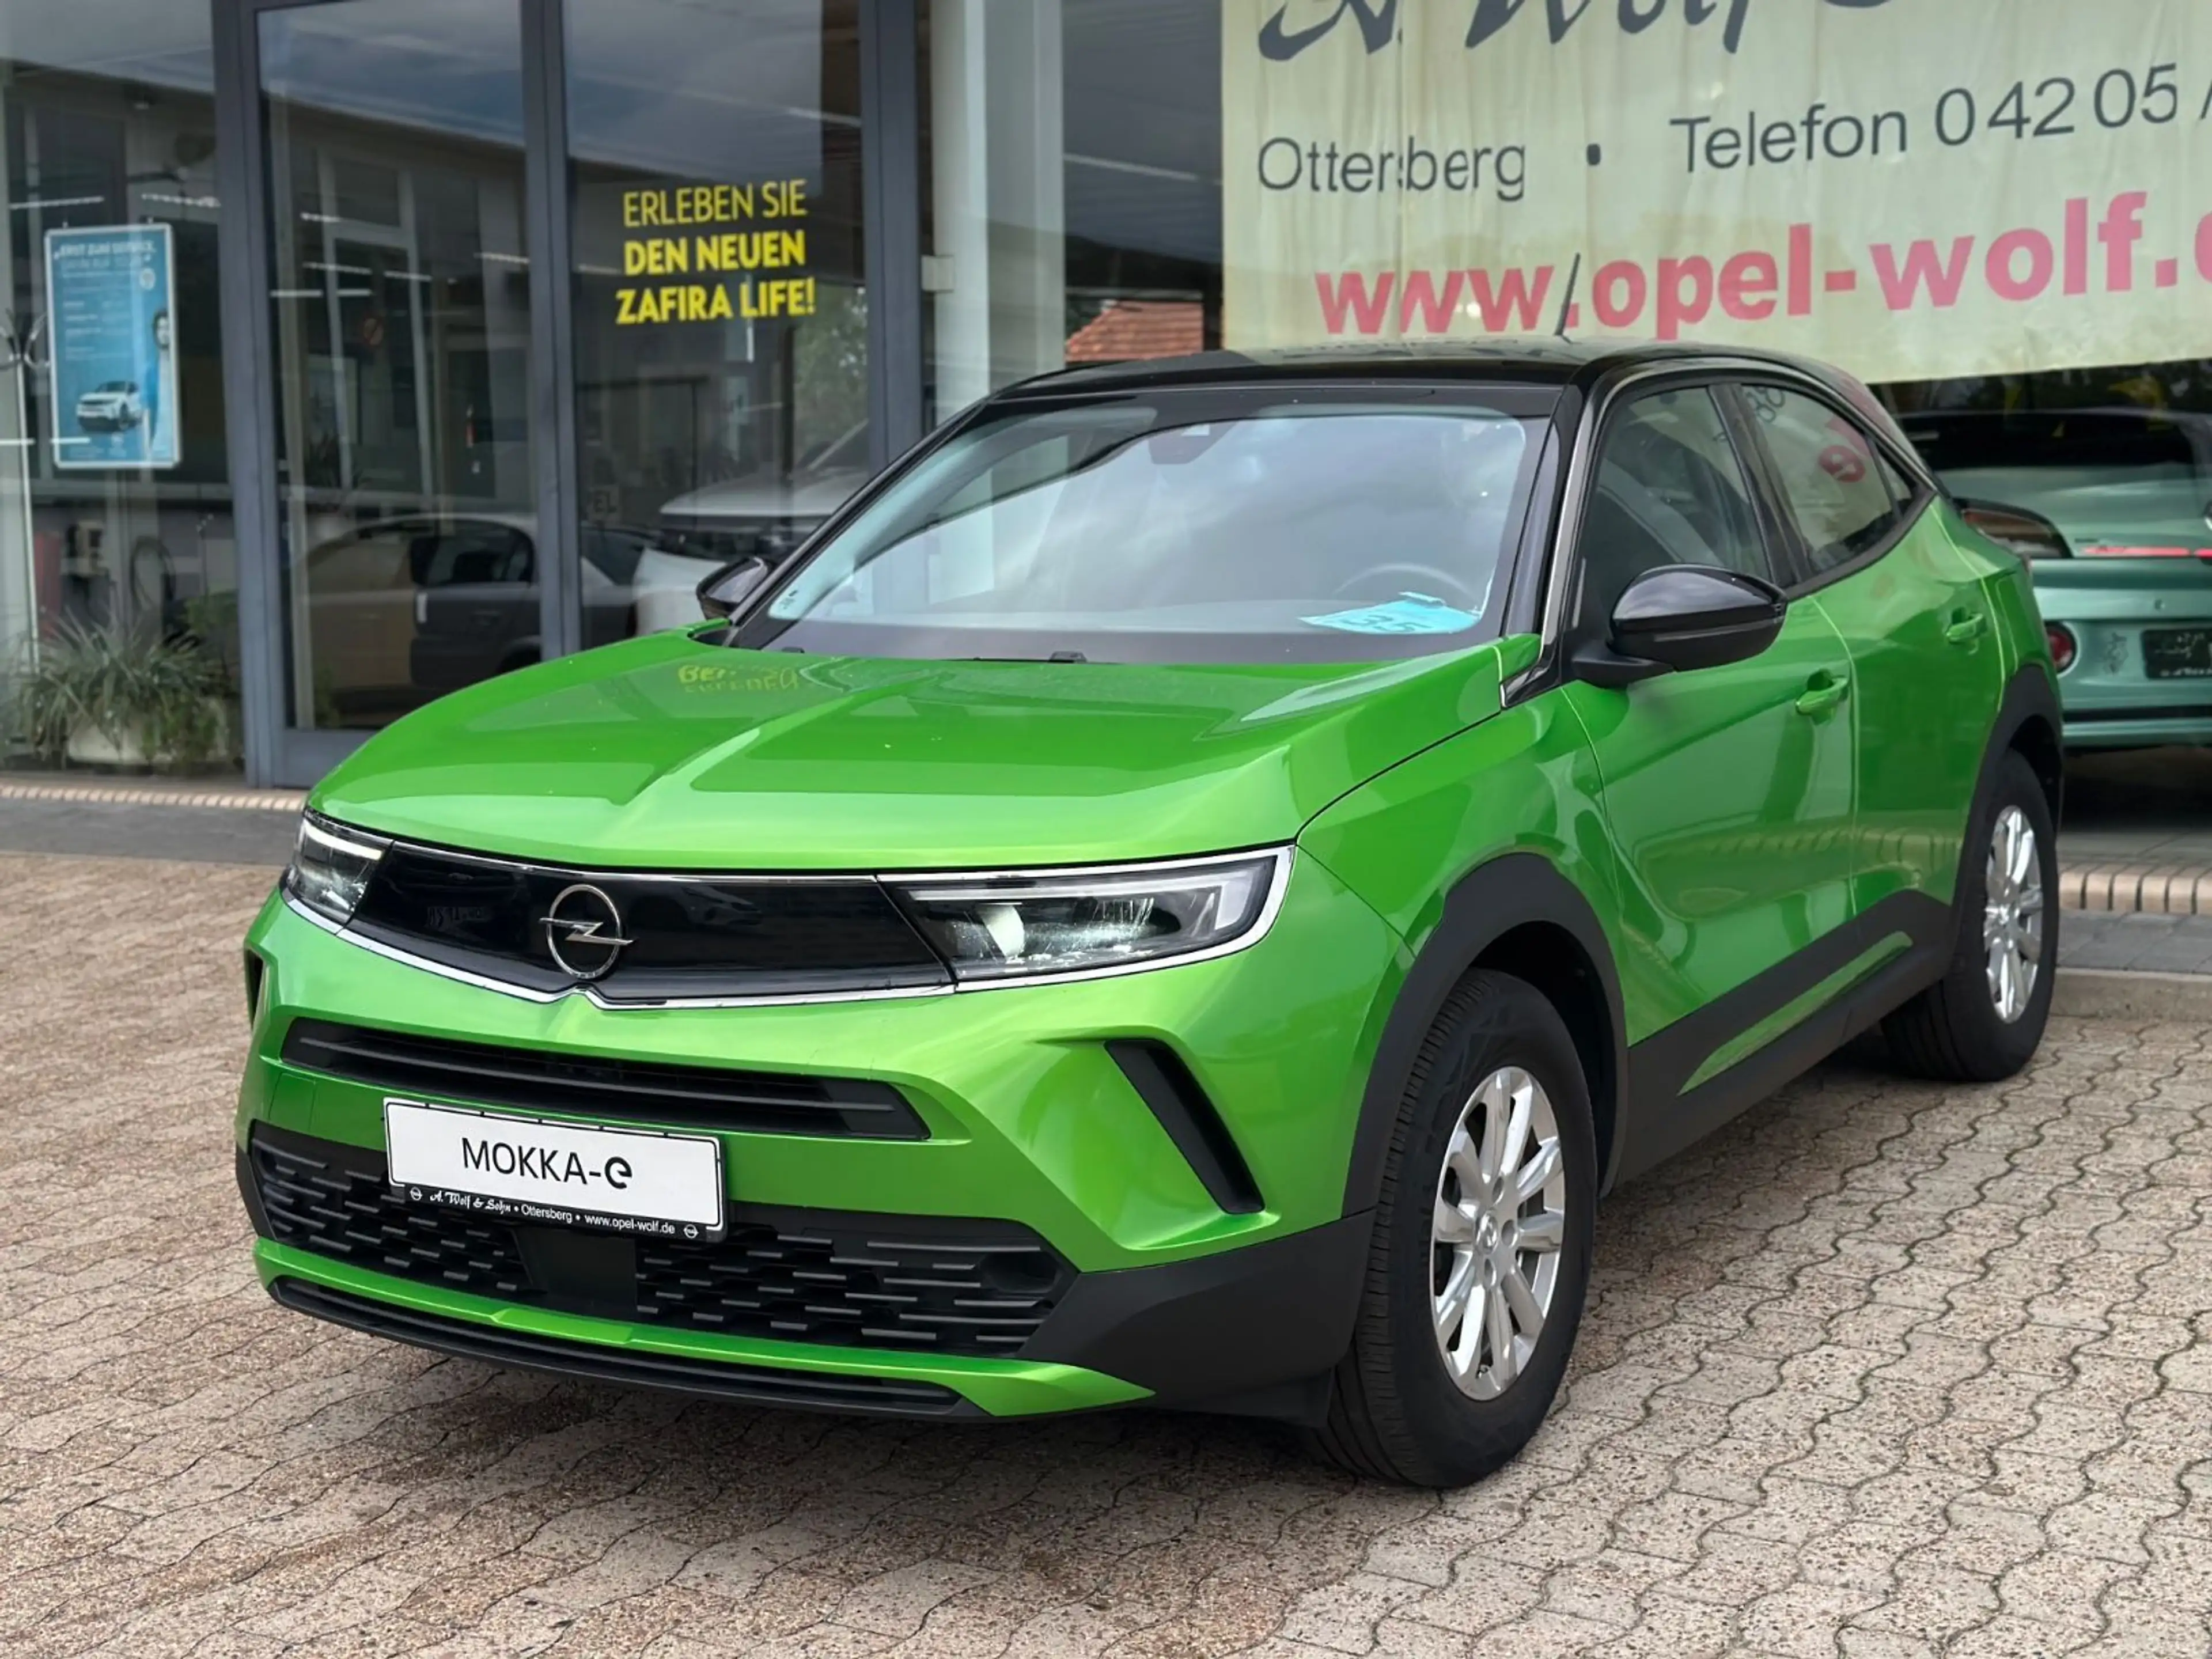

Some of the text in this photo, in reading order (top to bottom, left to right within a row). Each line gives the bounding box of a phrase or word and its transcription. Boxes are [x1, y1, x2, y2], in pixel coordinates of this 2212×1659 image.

[1669, 104, 1907, 173] Telefon
[623, 179, 808, 228] ERLEBEN SIE
[623, 229, 806, 277] DEN NEUEN
[615, 276, 817, 325] ZAFIRA LIFE!
[461, 1137, 633, 1190] MOKKA-e
[445, 1191, 471, 1209] Wolf
[521, 1203, 573, 1224] Ottersberg
[584, 1214, 676, 1234] www.opel-wolf.de
